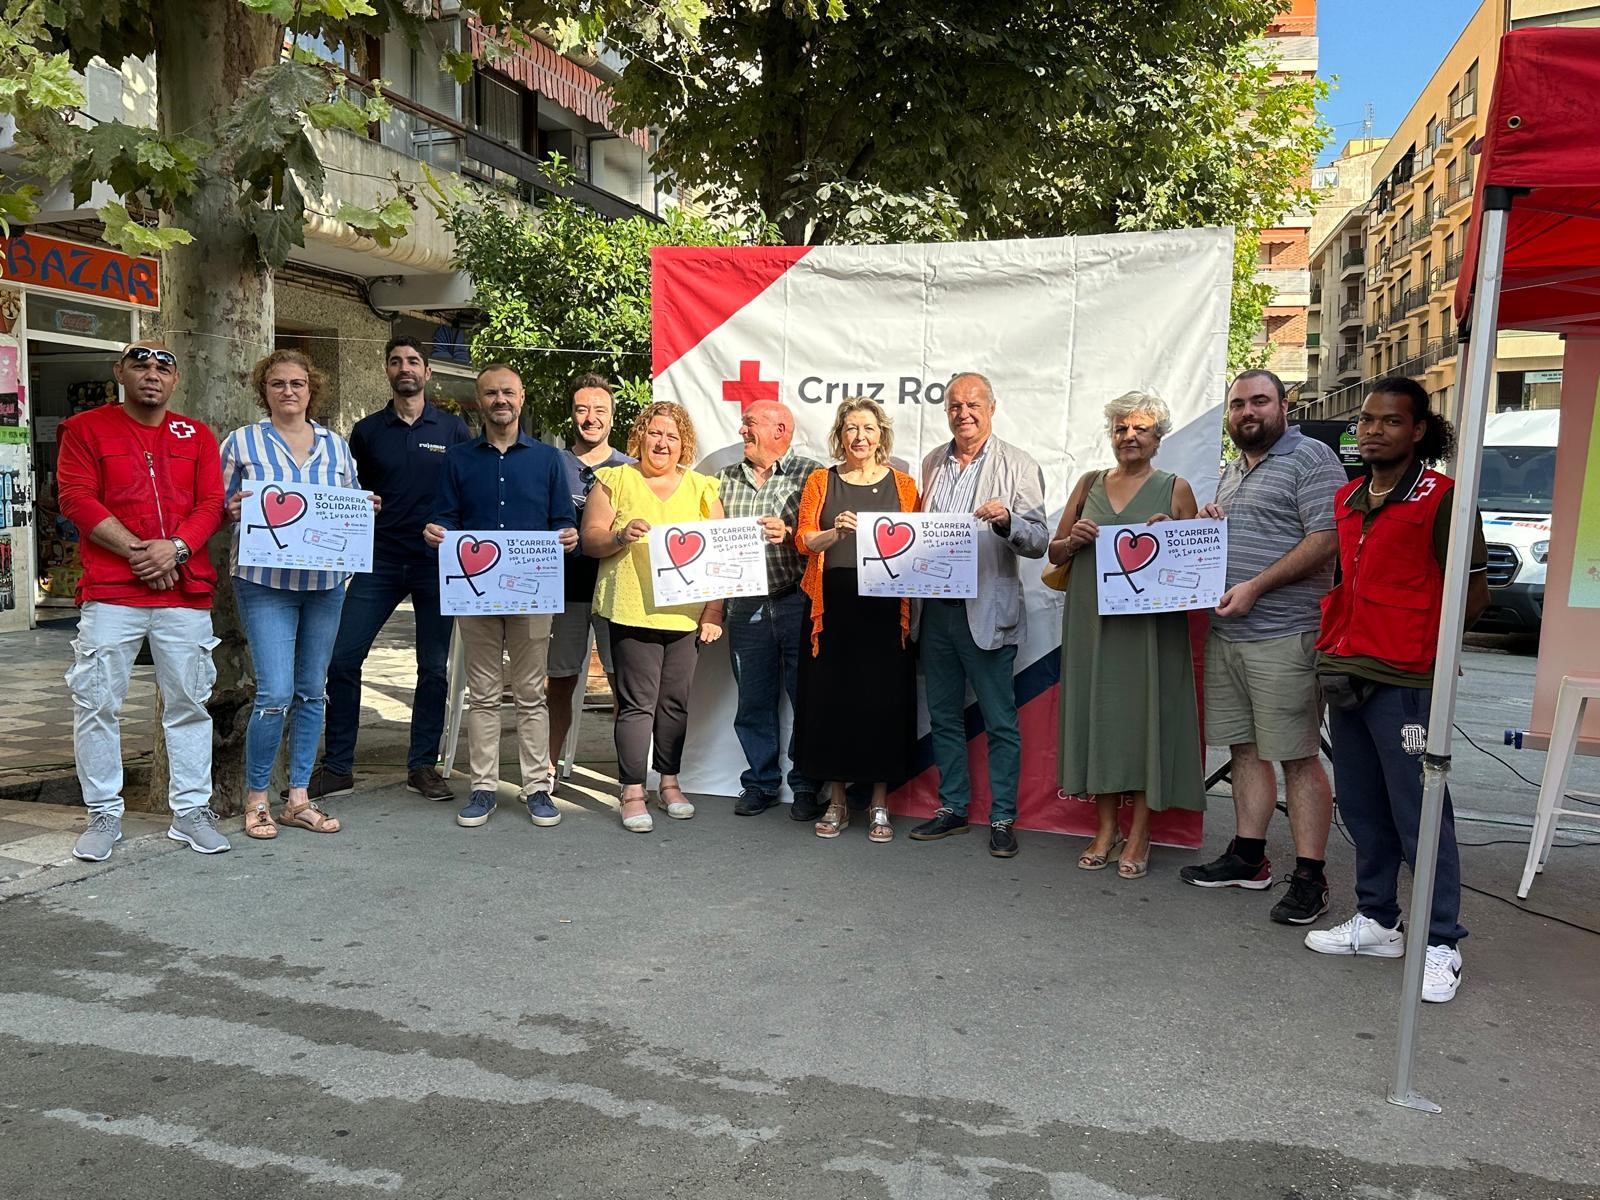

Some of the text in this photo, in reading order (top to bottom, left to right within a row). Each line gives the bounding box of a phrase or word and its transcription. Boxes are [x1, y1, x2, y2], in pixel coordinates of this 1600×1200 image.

[7, 237, 154, 300] BAZAR
[797, 374, 957, 404] Cruz Ro
[328, 495, 366, 504] CARRERA
[315, 501, 367, 511] SOLIDARIA
[1179, 527, 1220, 537] CARRERA
[712, 533, 757, 543] SOLIDARIA
[1167, 536, 1220, 547] SOLIDARIA
